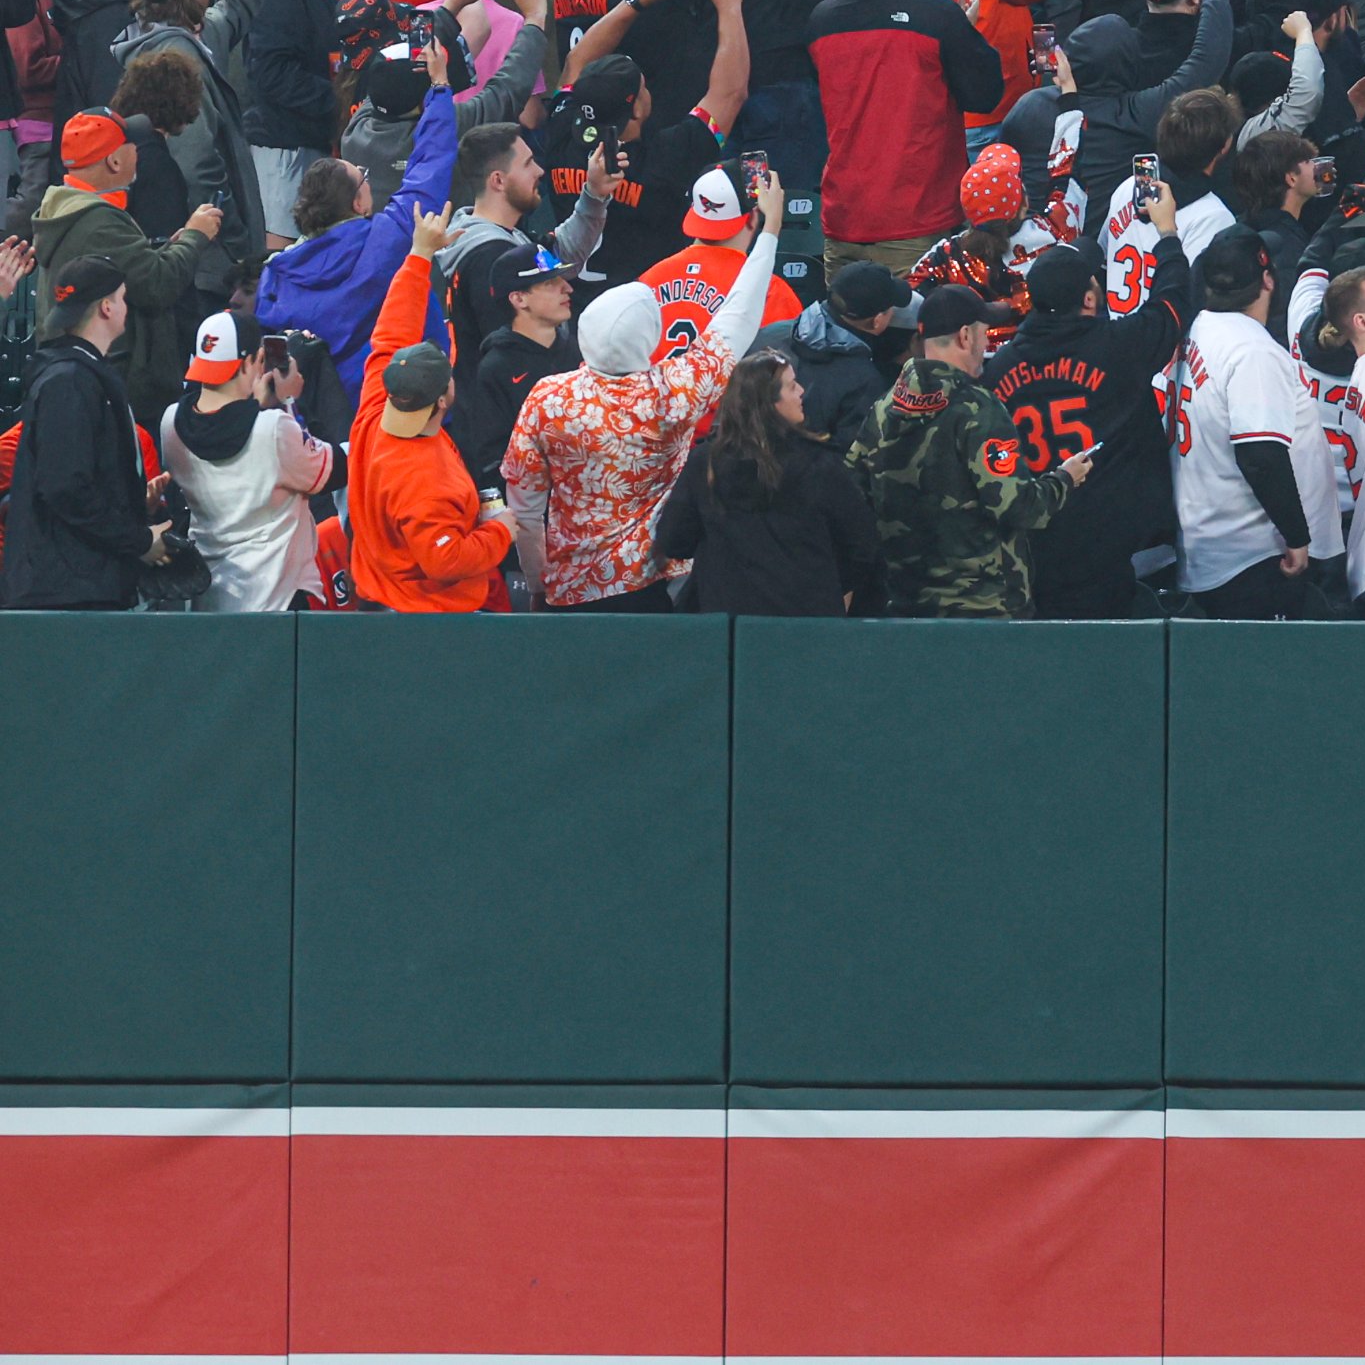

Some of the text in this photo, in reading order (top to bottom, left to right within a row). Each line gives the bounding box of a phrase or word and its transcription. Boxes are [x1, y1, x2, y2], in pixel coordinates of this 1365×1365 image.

[550, 167, 644, 208] HENDON
[658, 280, 726, 316] NDERSO
[667, 319, 699, 361] 2
[1012, 395, 1096, 473] 35
